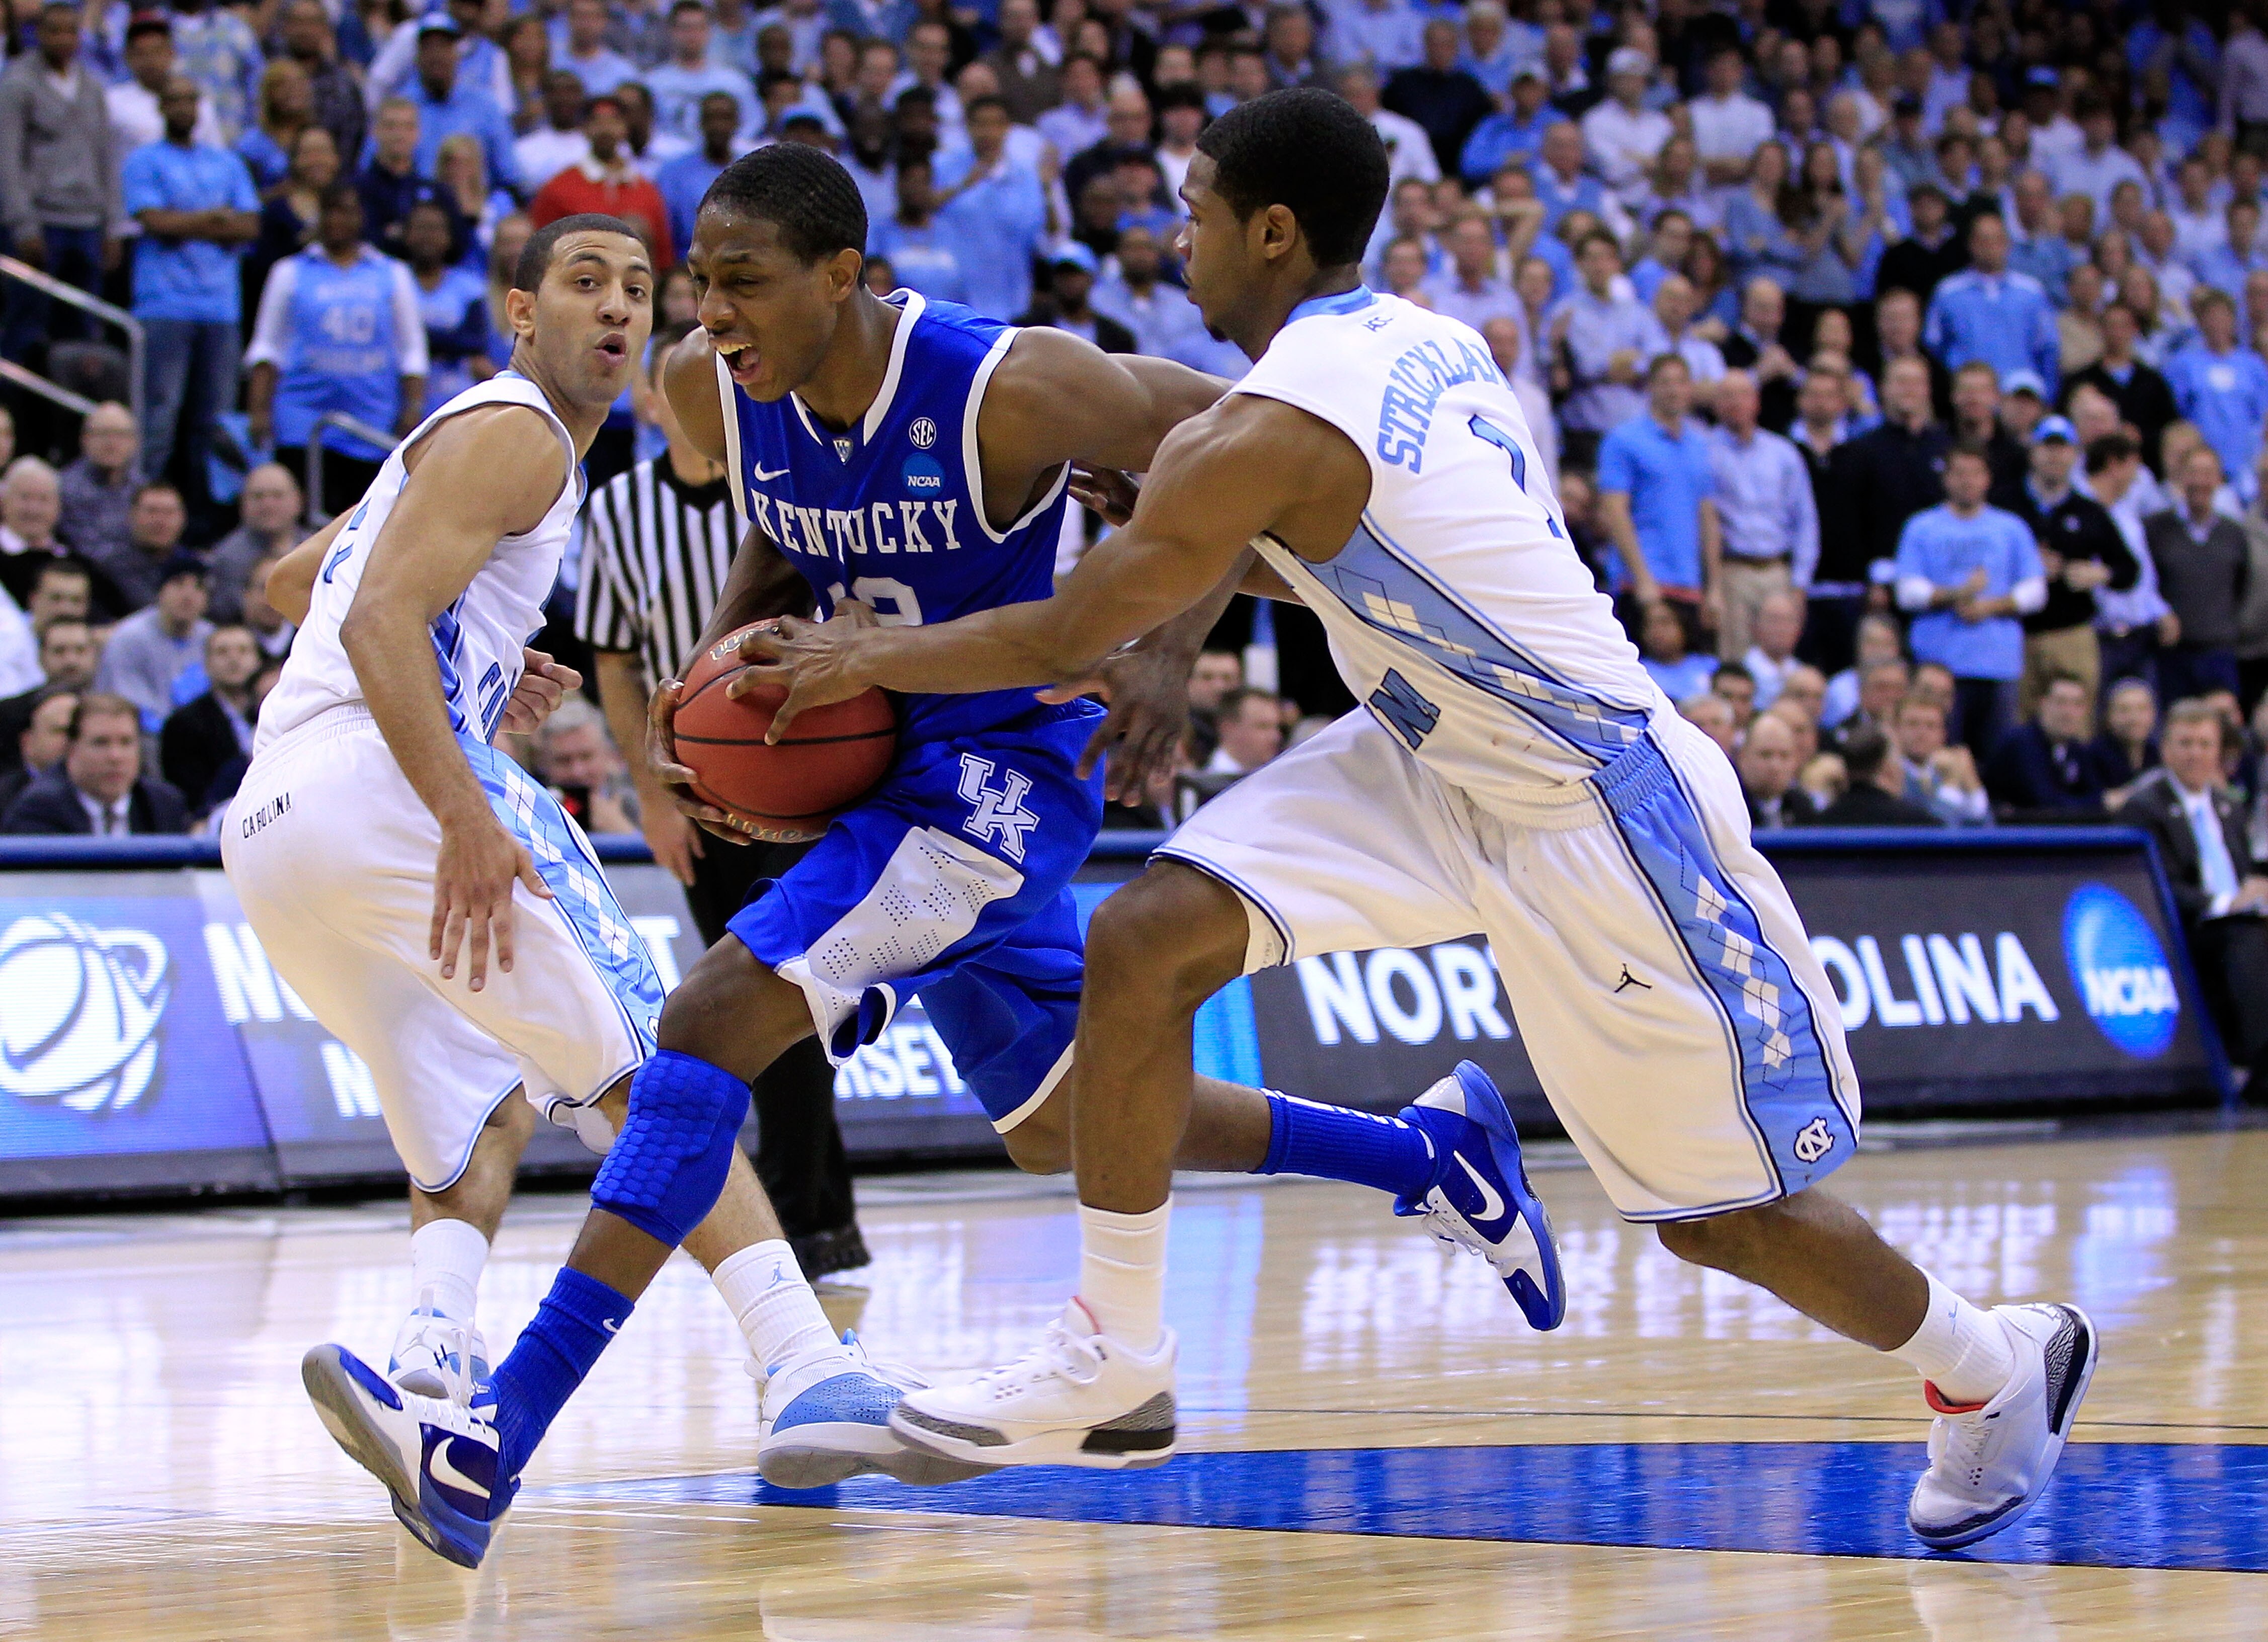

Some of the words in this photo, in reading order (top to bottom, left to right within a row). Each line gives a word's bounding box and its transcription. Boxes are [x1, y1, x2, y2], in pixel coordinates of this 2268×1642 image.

[912, 420, 934, 446] SEC
[907, 475, 941, 487] NCAA
[751, 488, 961, 564] KENTUCKY
[242, 791, 291, 839] CAROLINA
[957, 752, 1041, 865] UK
[1294, 942, 1512, 1046] NOR
[2082, 966, 2180, 1017] NCAA
